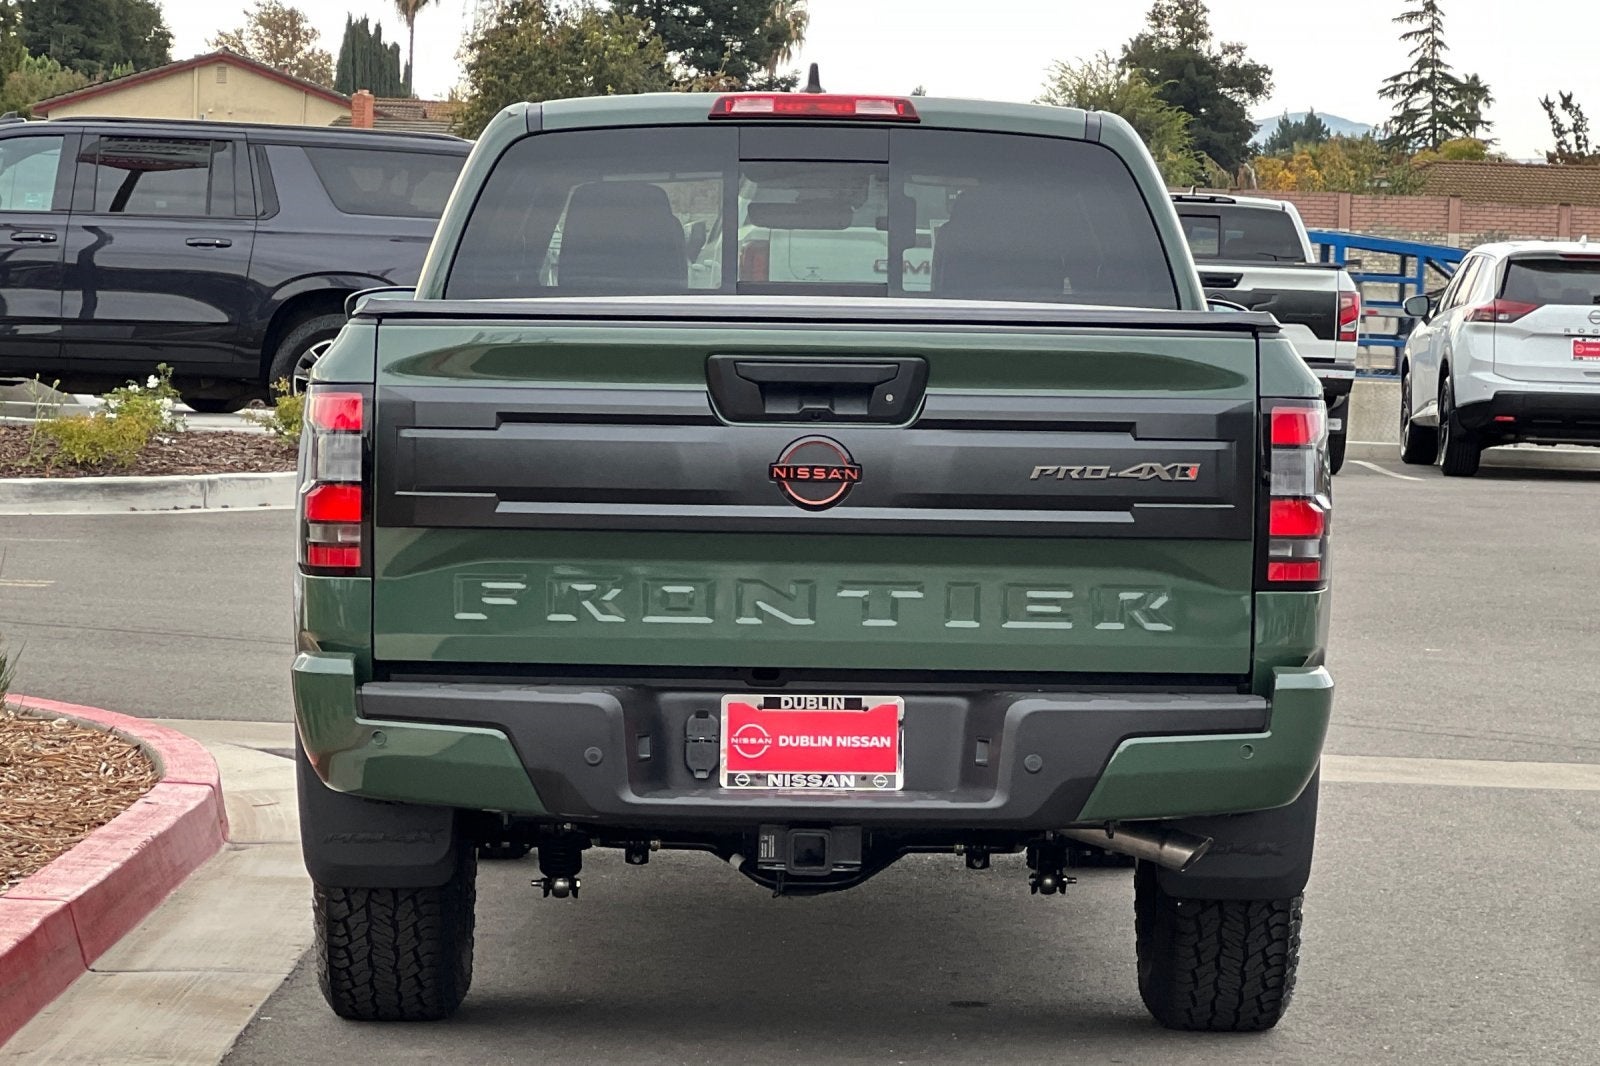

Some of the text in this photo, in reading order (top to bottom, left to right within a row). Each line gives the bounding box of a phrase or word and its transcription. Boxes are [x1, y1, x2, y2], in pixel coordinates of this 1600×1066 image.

[773, 467, 858, 480] NISSAN
[453, 573, 1174, 631] FRONTIER
[780, 696, 845, 710] DUBLIN
[730, 737, 773, 745] NISSAN
[778, 735, 891, 748] DUBLIN NISSAN
[767, 774, 856, 788] NISSAN
